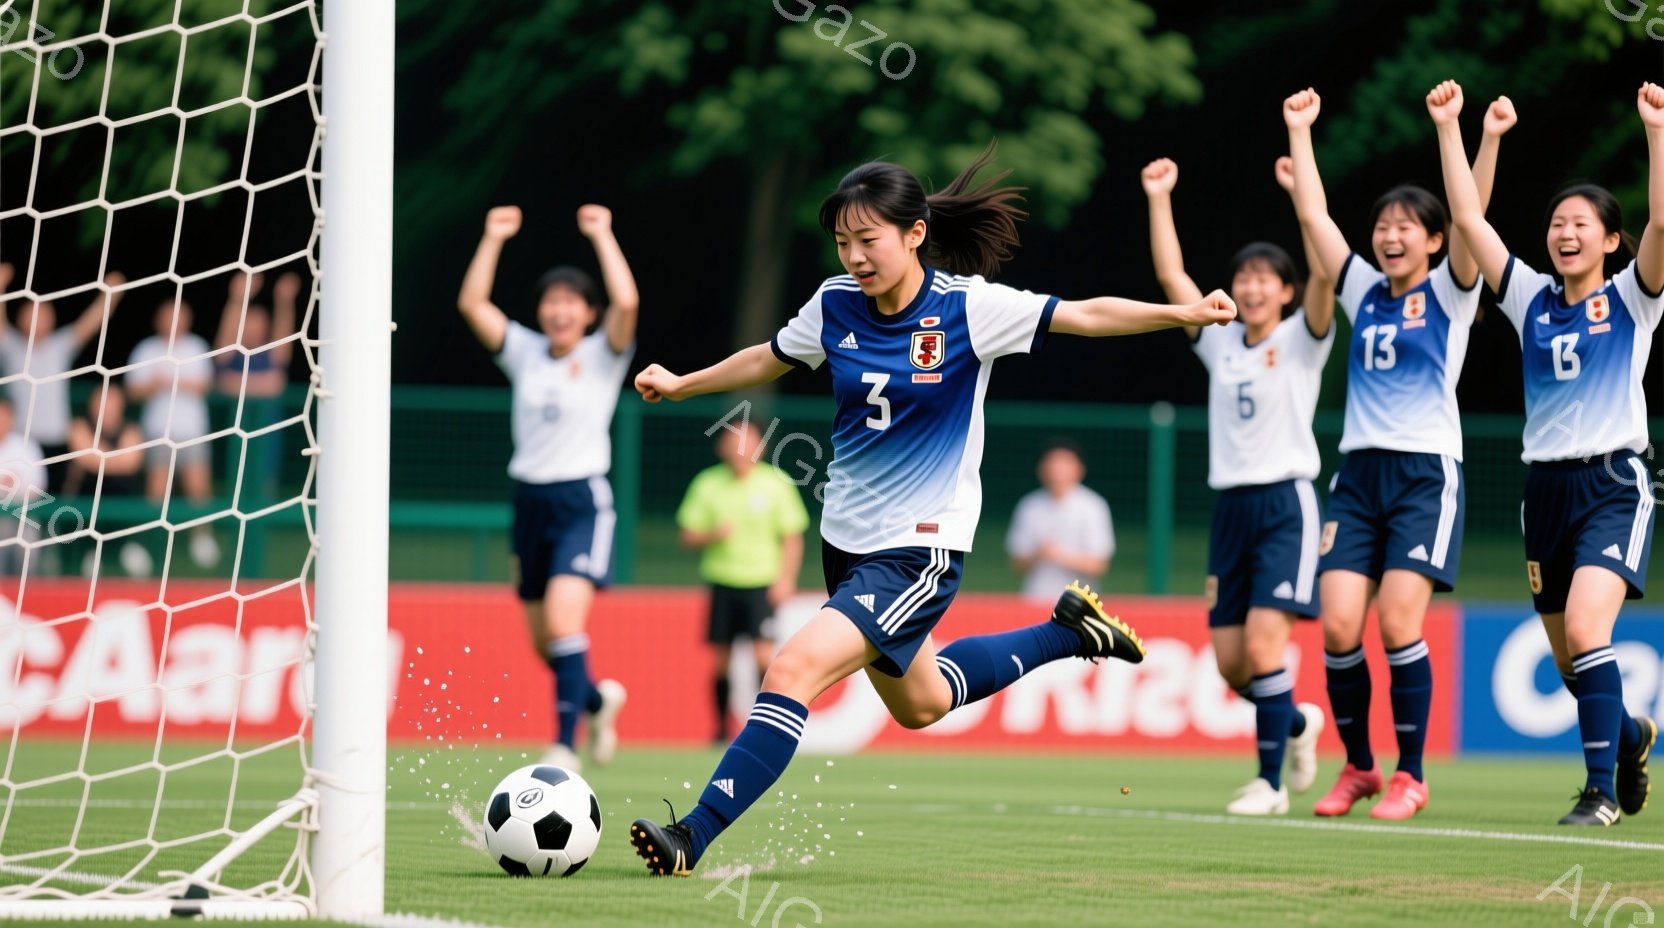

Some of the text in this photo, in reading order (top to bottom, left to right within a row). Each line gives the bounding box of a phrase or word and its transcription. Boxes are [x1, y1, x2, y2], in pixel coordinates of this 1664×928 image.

[1361, 324, 1398, 372] 13
[1551, 332, 1581, 381] 13
[861, 372, 891, 431] 3
